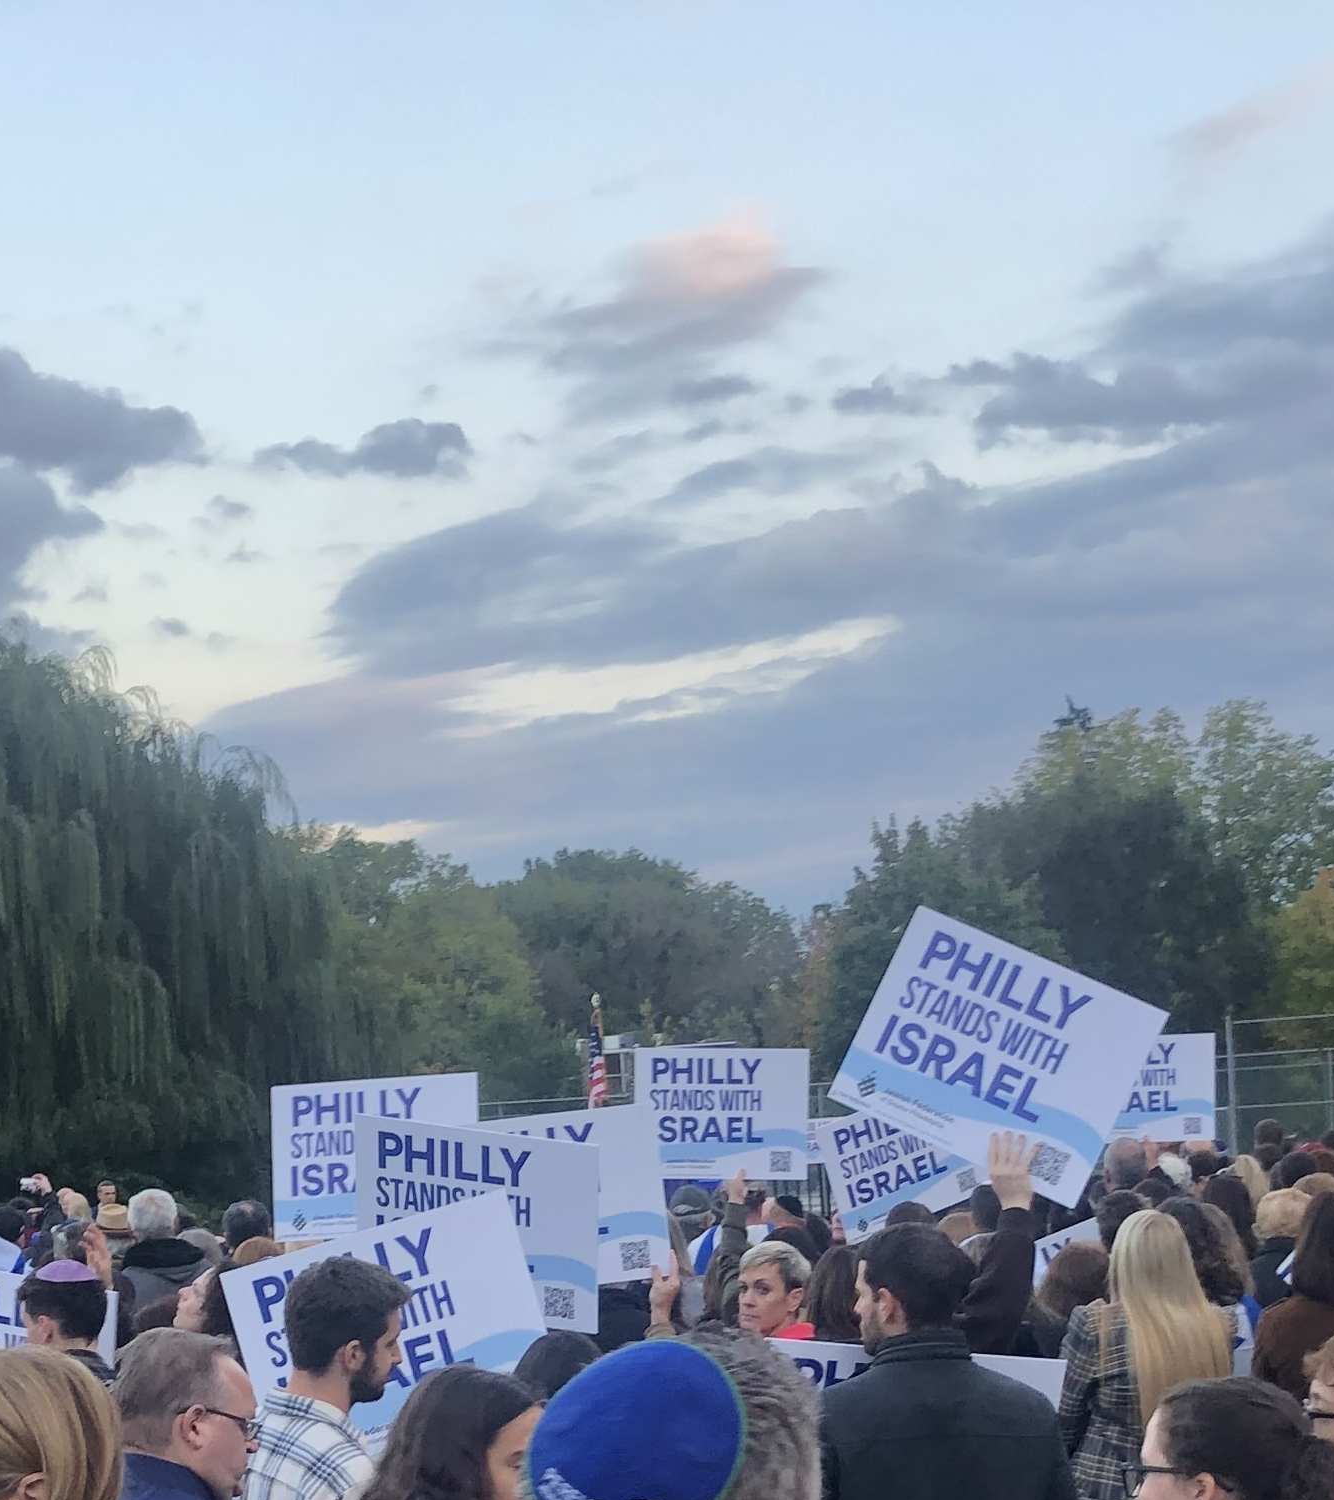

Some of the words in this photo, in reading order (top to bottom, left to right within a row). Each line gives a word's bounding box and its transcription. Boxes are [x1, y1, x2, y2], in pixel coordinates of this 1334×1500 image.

[918, 930, 1093, 1030] PHILLY
[899, 976, 1000, 1044] STANDS
[998, 1019, 1070, 1075] WITH
[651, 1057, 762, 1085] PHILLY
[874, 1014, 1040, 1123] ISRAEL
[650, 1089, 716, 1112] STANDS
[719, 1089, 762, 1112] WITH
[1120, 1090, 1178, 1114] AEL
[291, 1130, 355, 1159] STAND
[657, 1116, 764, 1143] SRAEL
[377, 1130, 532, 1188] PHILLY
[840, 1140, 899, 1179] STANDS
[291, 1162, 357, 1197] ISR
[846, 1151, 948, 1208] ISRAEL
